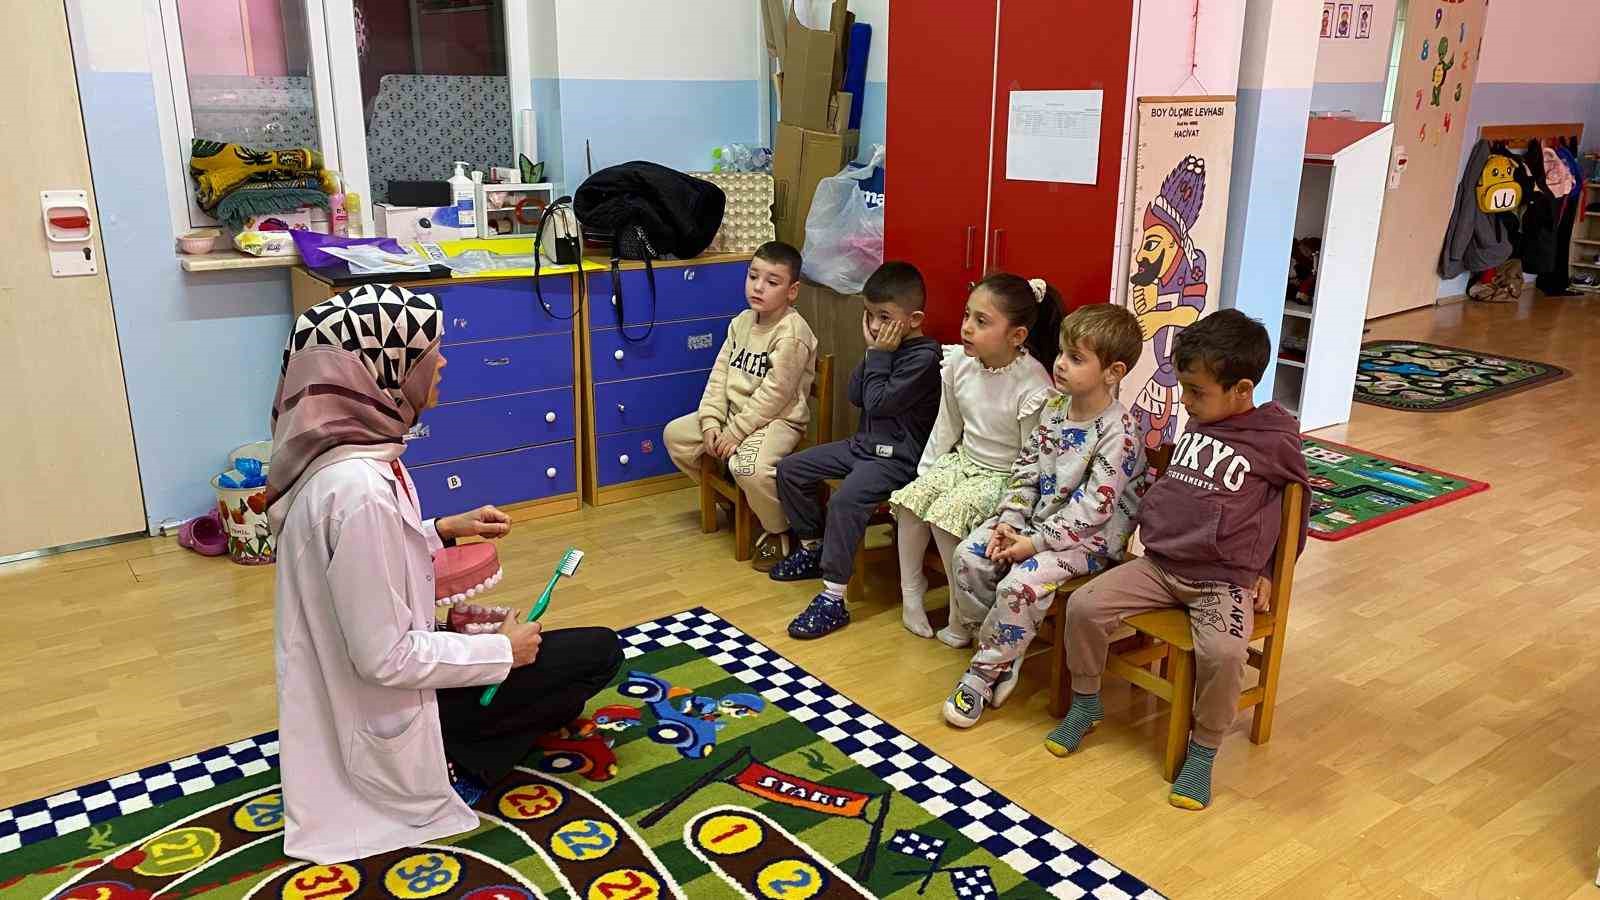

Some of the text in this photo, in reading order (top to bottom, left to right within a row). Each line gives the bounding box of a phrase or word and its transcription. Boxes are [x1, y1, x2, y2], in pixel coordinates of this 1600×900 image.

[1435, 8, 1442, 29] 9
[1421, 40, 1429, 60] 8
[1415, 89, 1423, 110] 7
[1151, 107, 1225, 118] BOY ÖLÇME LEVHASI
[1443, 113, 1451, 132] 4
[1419, 123, 1426, 142] 6
[1170, 432, 1251, 492] OKYO
[451, 477, 458, 487] B
[1229, 605, 1244, 639] PLAY
[505, 784, 558, 817] 23
[757, 776, 850, 807] START
[559, 821, 612, 857] 22
[711, 823, 748, 844] 1
[396, 855, 452, 893] 38
[768, 868, 812, 895] 2
